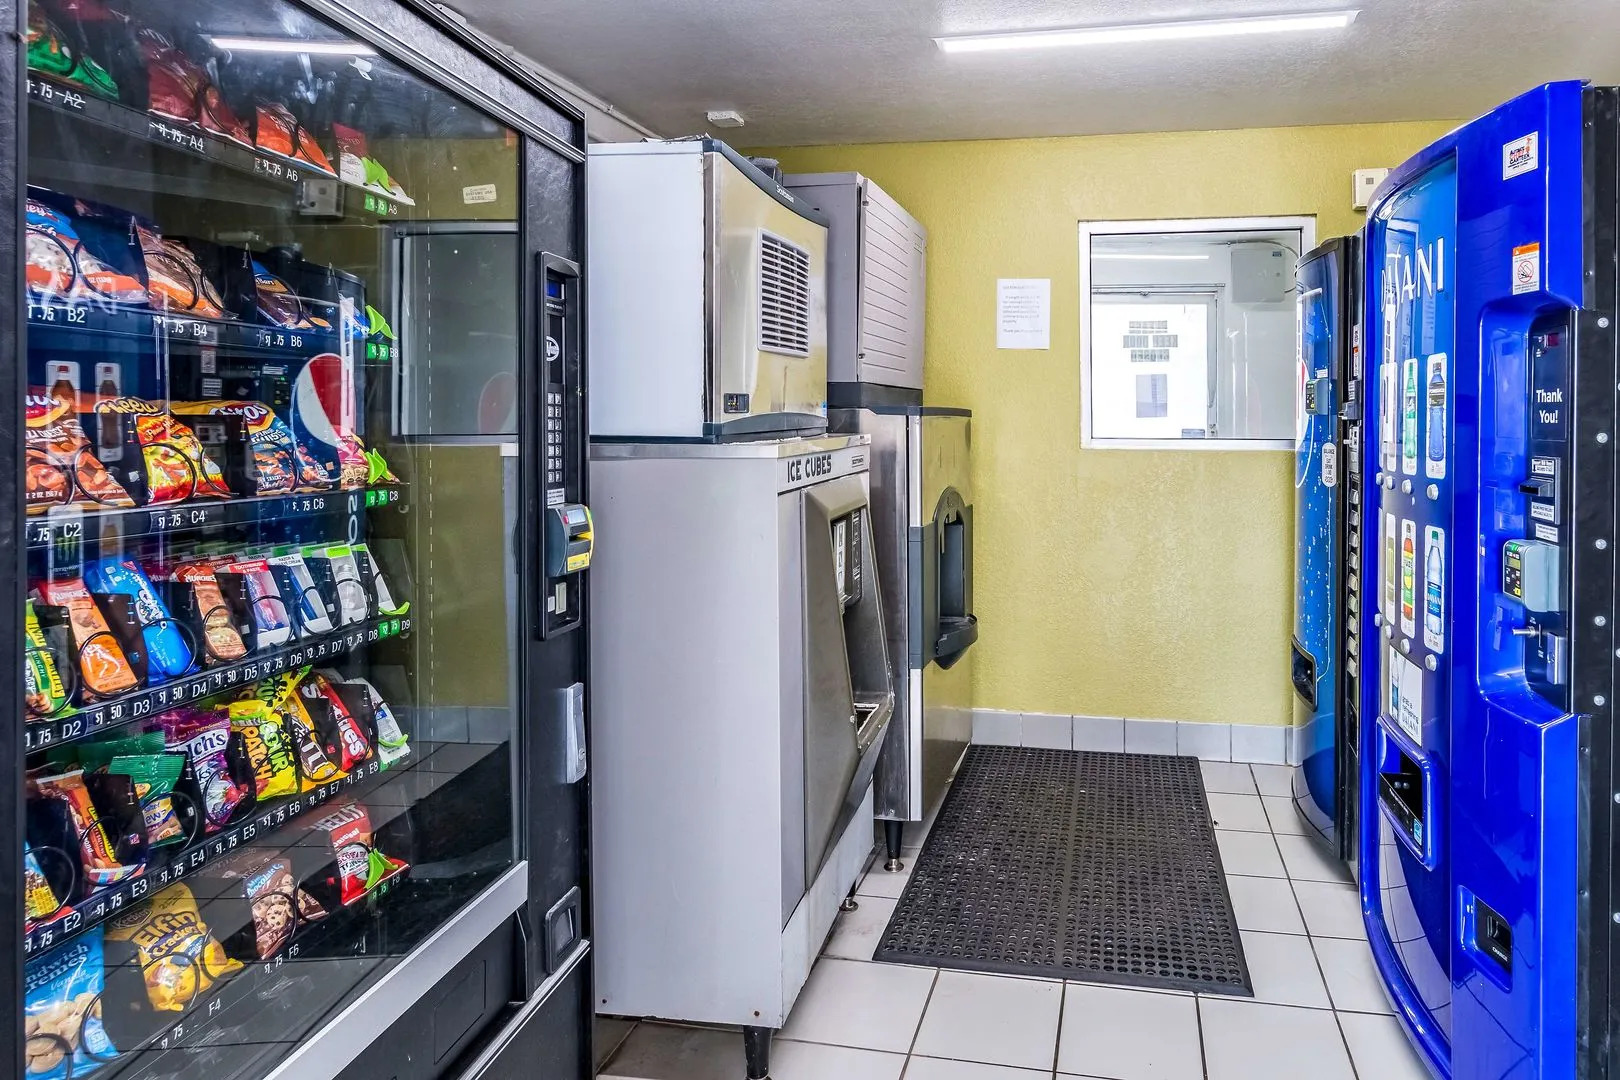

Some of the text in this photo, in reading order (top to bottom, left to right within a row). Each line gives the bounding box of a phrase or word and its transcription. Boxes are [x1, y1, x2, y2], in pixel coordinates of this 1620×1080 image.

[64, 90, 85, 109] A2
[190, 135, 203, 150] A4
[286, 168, 298, 182] A6
[388, 203, 397, 215] A8
[67, 308, 85, 323] B2
[193, 323, 208, 336] B4
[291, 335, 302, 347] B6
[390, 347, 399, 358] B8
[1536, 388, 1562, 403] Thank
[1539, 410, 1558, 424] You!
[787, 454, 832, 483] ICE CUBES
[313, 498, 324, 509] C6
[389, 491, 398, 501] C8
[191, 510, 205, 524] C4
[63, 522, 82, 538] C2
[401, 620, 411, 631] D9
[368, 629, 378, 641] D8
[331, 642, 343, 653] D7
[31, 650, 46, 678] RUNCHY
[263, 653, 302, 673] $2.75 D6
[244, 666, 258, 681] D5
[192, 682, 207, 698] D4
[133, 700, 150, 716] D3
[62, 720, 81, 739] D2
[186, 732, 227, 758] lch's
[240, 725, 273, 780] PATCH
[259, 721, 289, 773] SOUR
[369, 762, 379, 774] E8
[330, 781, 340, 795] E7
[263, 801, 300, 827] $1.75 E6
[243, 824, 256, 840] E5
[191, 850, 205, 868] E4
[132, 879, 148, 898] E3
[64, 912, 82, 933] E2
[137, 912, 196, 947] Elfin
[288, 943, 299, 959] F6
[208, 998, 221, 1016] F4
